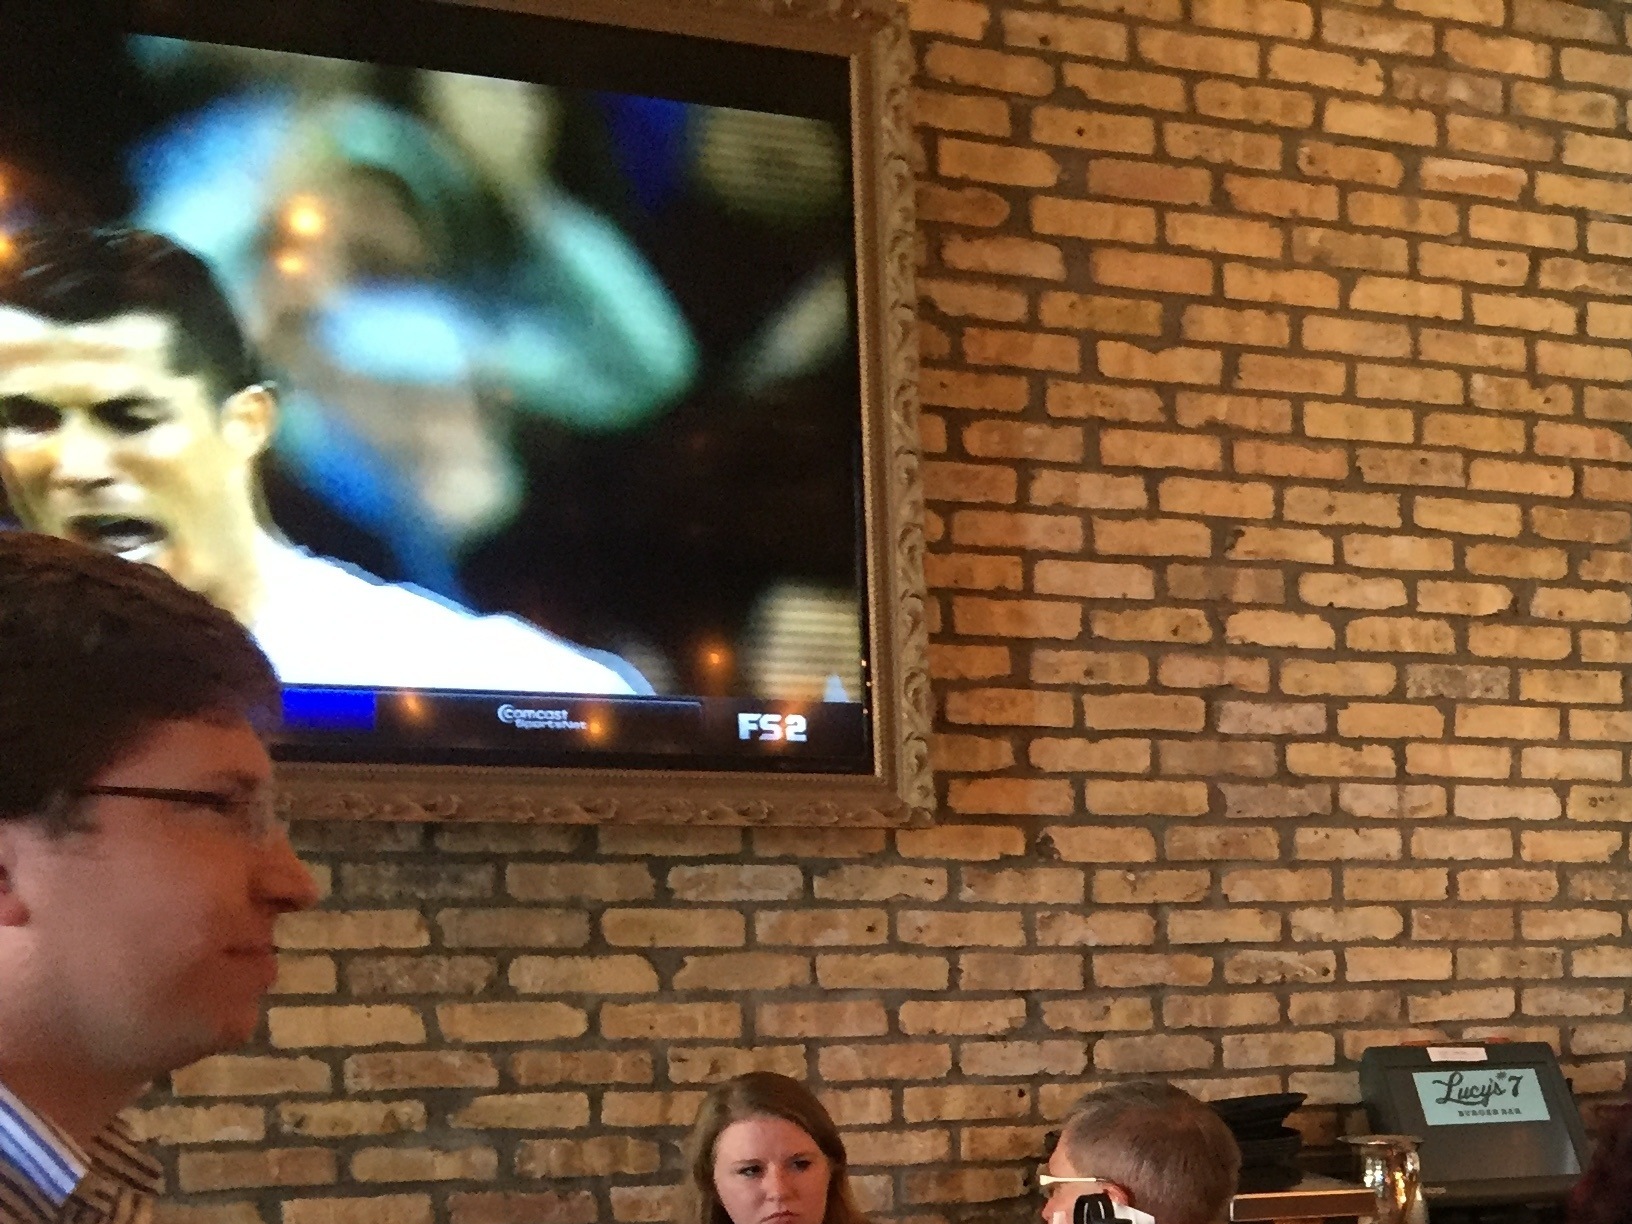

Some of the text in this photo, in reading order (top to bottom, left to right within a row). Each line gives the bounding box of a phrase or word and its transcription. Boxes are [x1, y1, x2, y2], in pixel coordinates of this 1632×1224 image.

[497, 703, 568, 724] Comcast
[738, 713, 807, 742] FS2
[1432, 1071, 1506, 1107] Lucy's
[1458, 1107, 1522, 1118] BURGER BAR
